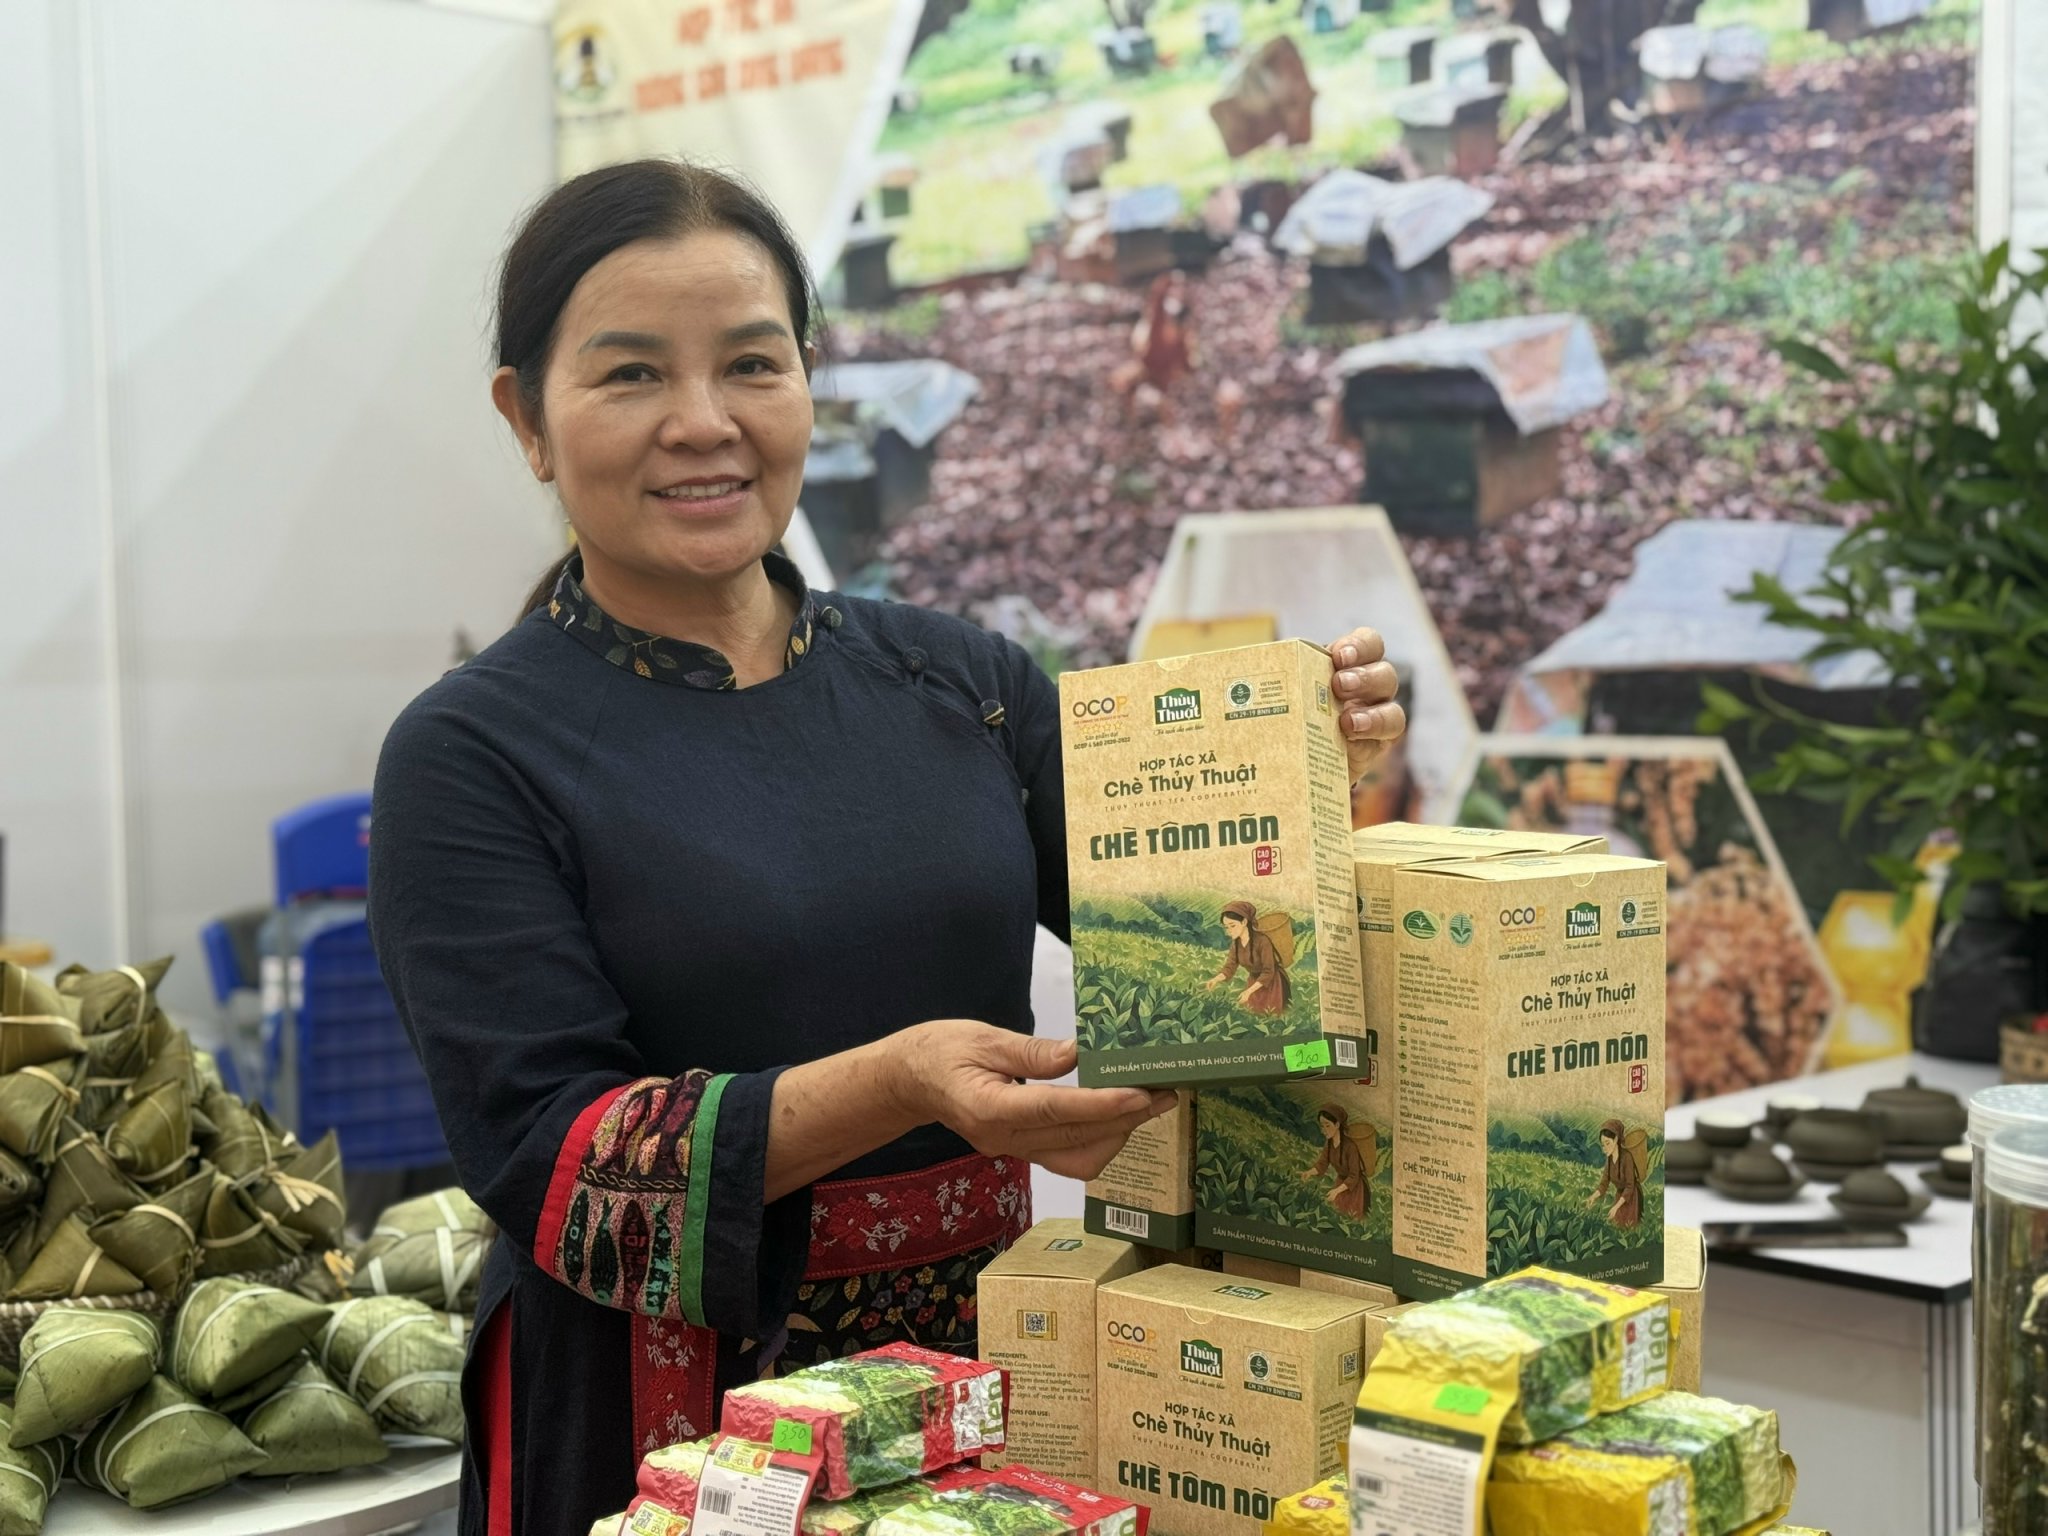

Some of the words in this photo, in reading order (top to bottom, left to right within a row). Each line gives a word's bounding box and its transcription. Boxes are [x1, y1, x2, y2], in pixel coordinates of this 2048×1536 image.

[1073, 696, 1127, 717] OCOP
[1159, 694, 1196, 708] Thủy
[1157, 704, 1200, 722] Thuật
[1140, 759, 1166, 772] HỢP
[1169, 754, 1194, 767] TÁC
[1199, 751, 1216, 764] XÃ
[1104, 778, 1143, 797] Chè
[1149, 771, 1194, 792] Thủy
[1200, 764, 1257, 786] Thuật
[1090, 827, 1138, 861] CHÈ
[1146, 821, 1210, 854] TÔM
[1257, 850, 1269, 858] CAO
[1499, 906, 1545, 926] OCOP
[1570, 909, 1597, 923] Thủy
[1551, 975, 1571, 989] HỢP
[1575, 971, 1592, 983] TÁC
[1595, 968, 1609, 981] XÃ
[1521, 992, 1553, 1013] Chè
[1557, 987, 1591, 1009] Thủy
[1596, 983, 1636, 1005] Thuật
[1100, 1064, 1117, 1075] SẢN
[1118, 1061, 1140, 1073] PHẨM
[1141, 1061, 1151, 1071] TỪ
[1152, 1059, 1176, 1070] NÔNG
[1178, 1058, 1195, 1068] TRẠI
[1196, 1056, 1212, 1066] TRÀ
[1213, 1055, 1231, 1065] HỮU
[1232, 1055, 1244, 1063] CƠ
[1246, 1053, 1267, 1063] THỦY
[1269, 1053, 1285, 1062] THU
[1508, 1044, 1545, 1078] CHÈ
[1552, 1039, 1599, 1072] TÔM
[1403, 1161, 1418, 1173] CHÈ
[1419, 1164, 1439, 1177] THỦY
[1441, 1170, 1467, 1184] THUẬT
[1212, 1227, 1226, 1236] SẢN
[1227, 1229, 1246, 1240] PHẨM
[1256, 1236, 1276, 1246] NÔNG
[1277, 1240, 1291, 1250] TRẠI
[1605, 1269, 1614, 1277] CƠ
[1631, 1262, 1649, 1273] THUẬT
[1108, 1321, 1156, 1344] OCOP
[1185, 1343, 1218, 1365] Thủy
[1182, 1356, 1221, 1376] Thuật
[1165, 1402, 1189, 1417] HỢP
[1192, 1407, 1215, 1422] TÁC
[1219, 1413, 1235, 1427] XÃ
[1132, 1411, 1168, 1434] Chè
[1173, 1420, 1214, 1447] Thủy
[1219, 1431, 1271, 1461] Thuật
[1210, 1453, 1271, 1472] COOPERATIVE
[1119, 1460, 1161, 1495] CHÈ
[1168, 1471, 1226, 1511] TÔM
